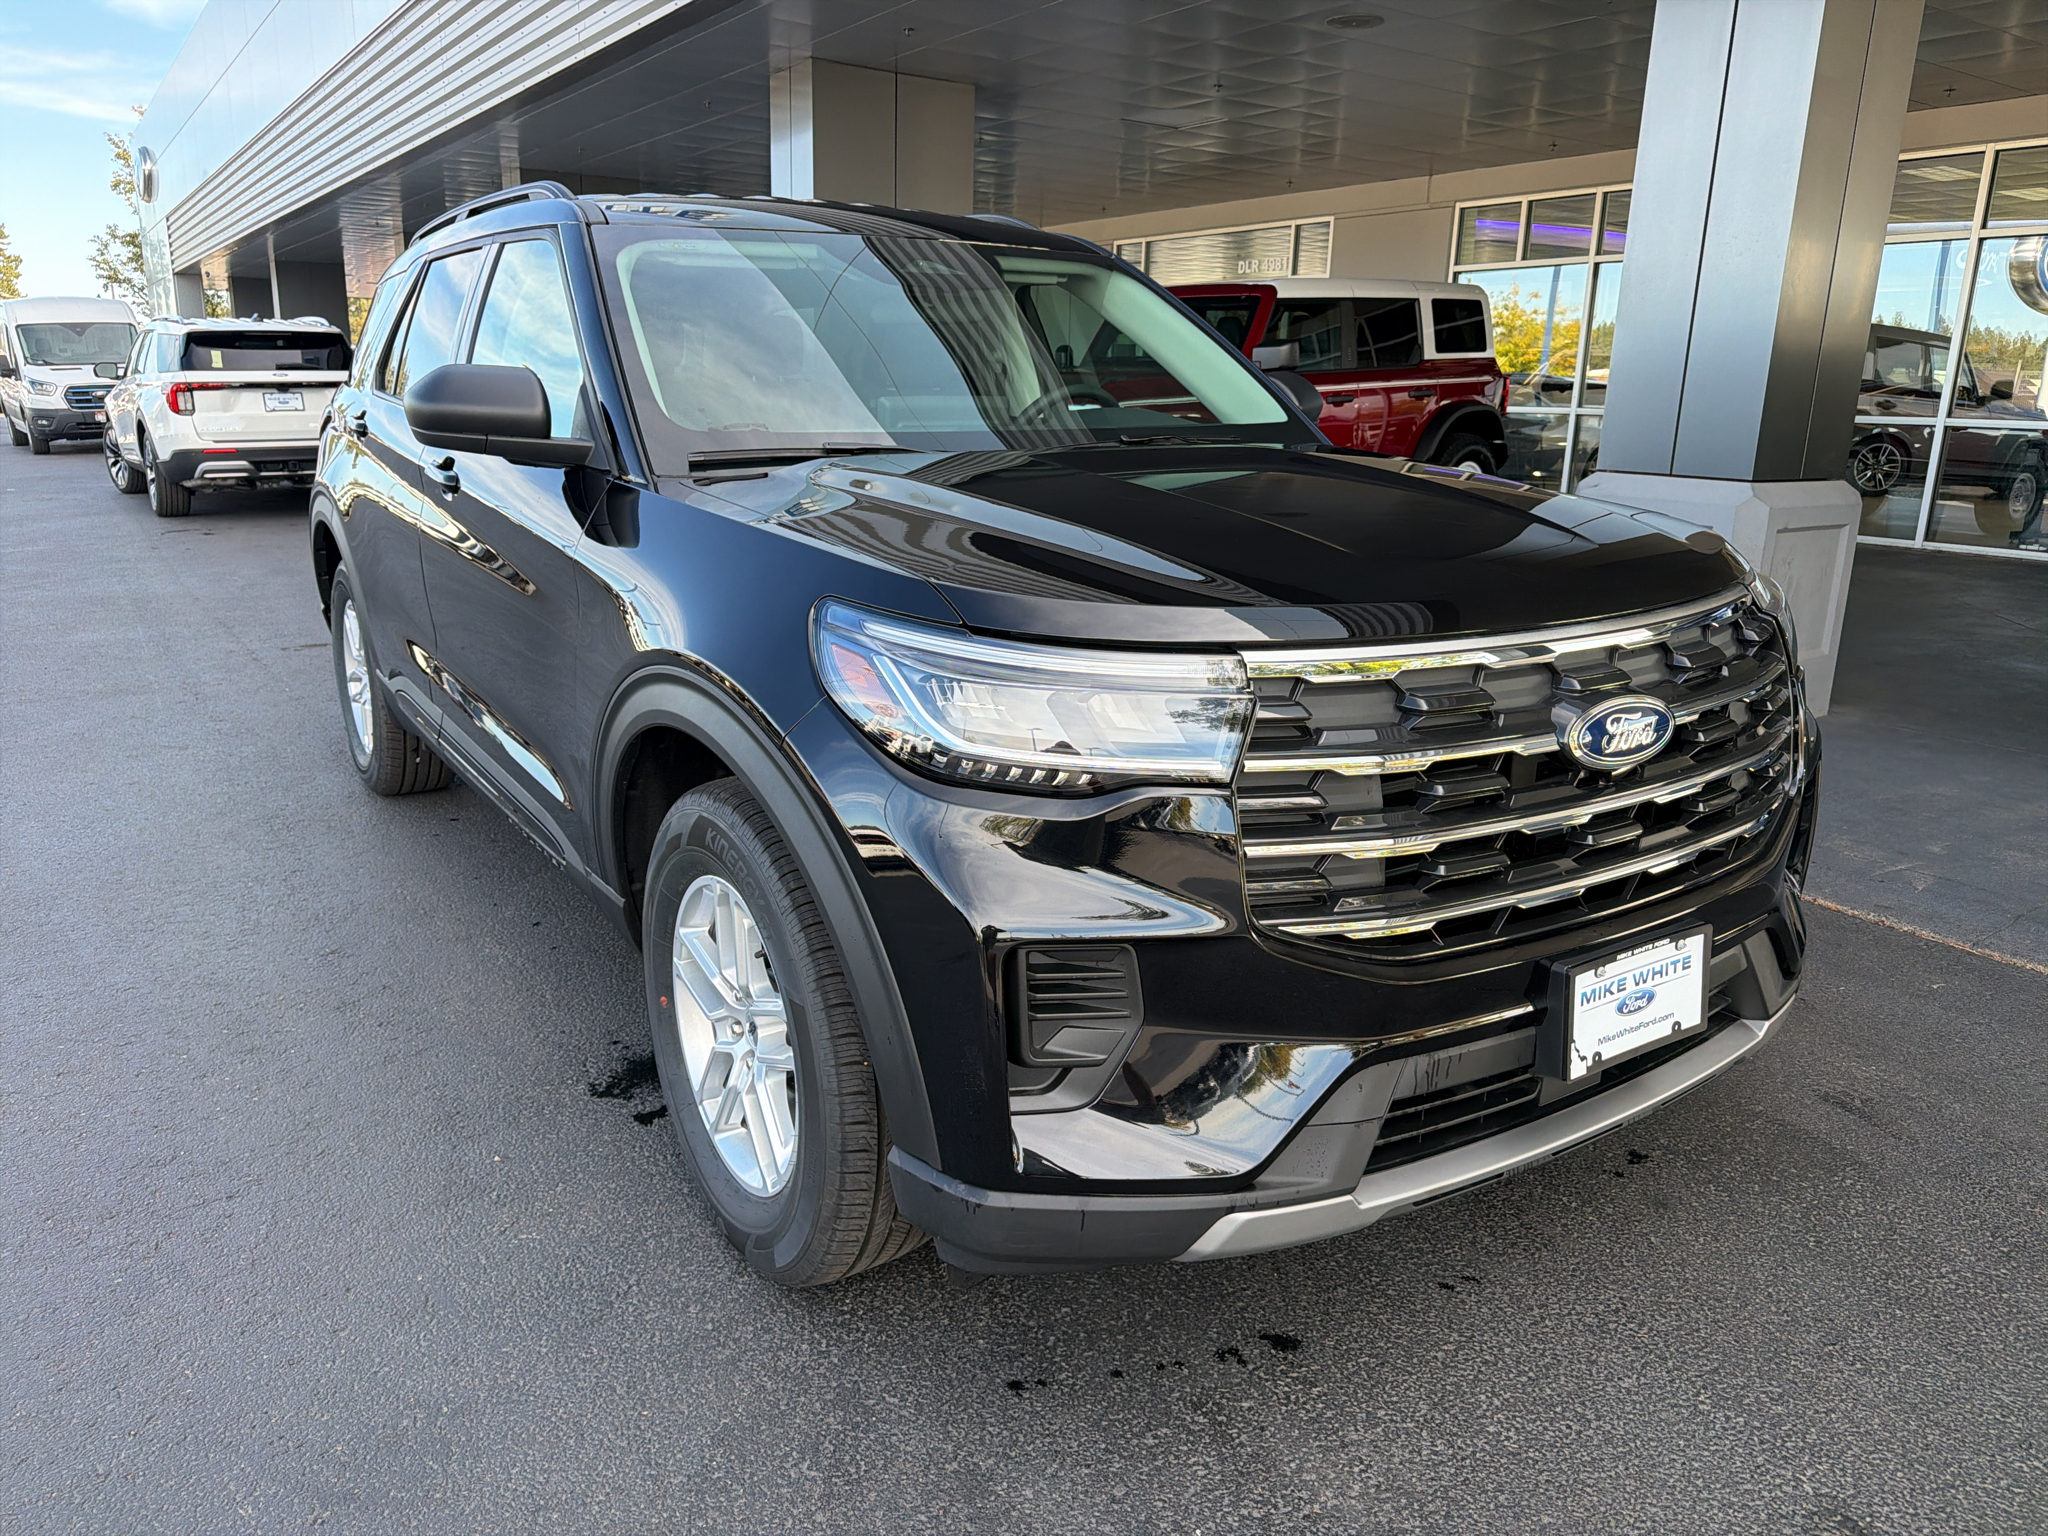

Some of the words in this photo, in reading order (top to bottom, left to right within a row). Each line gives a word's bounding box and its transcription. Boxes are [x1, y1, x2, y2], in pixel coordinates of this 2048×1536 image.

[1238, 260, 1259, 274] DLR
[1602, 712, 1659, 754] Ford
[1616, 949, 1633, 961] MIKE
[1633, 942, 1654, 955] WHITE
[1654, 938, 1671, 949] FORD
[1580, 976, 1627, 1007] MIKE
[1633, 955, 1692, 987] WHITE
[1622, 992, 1650, 1014] Ford
[1597, 1012, 1675, 1047] MikeWhiteFord.com
